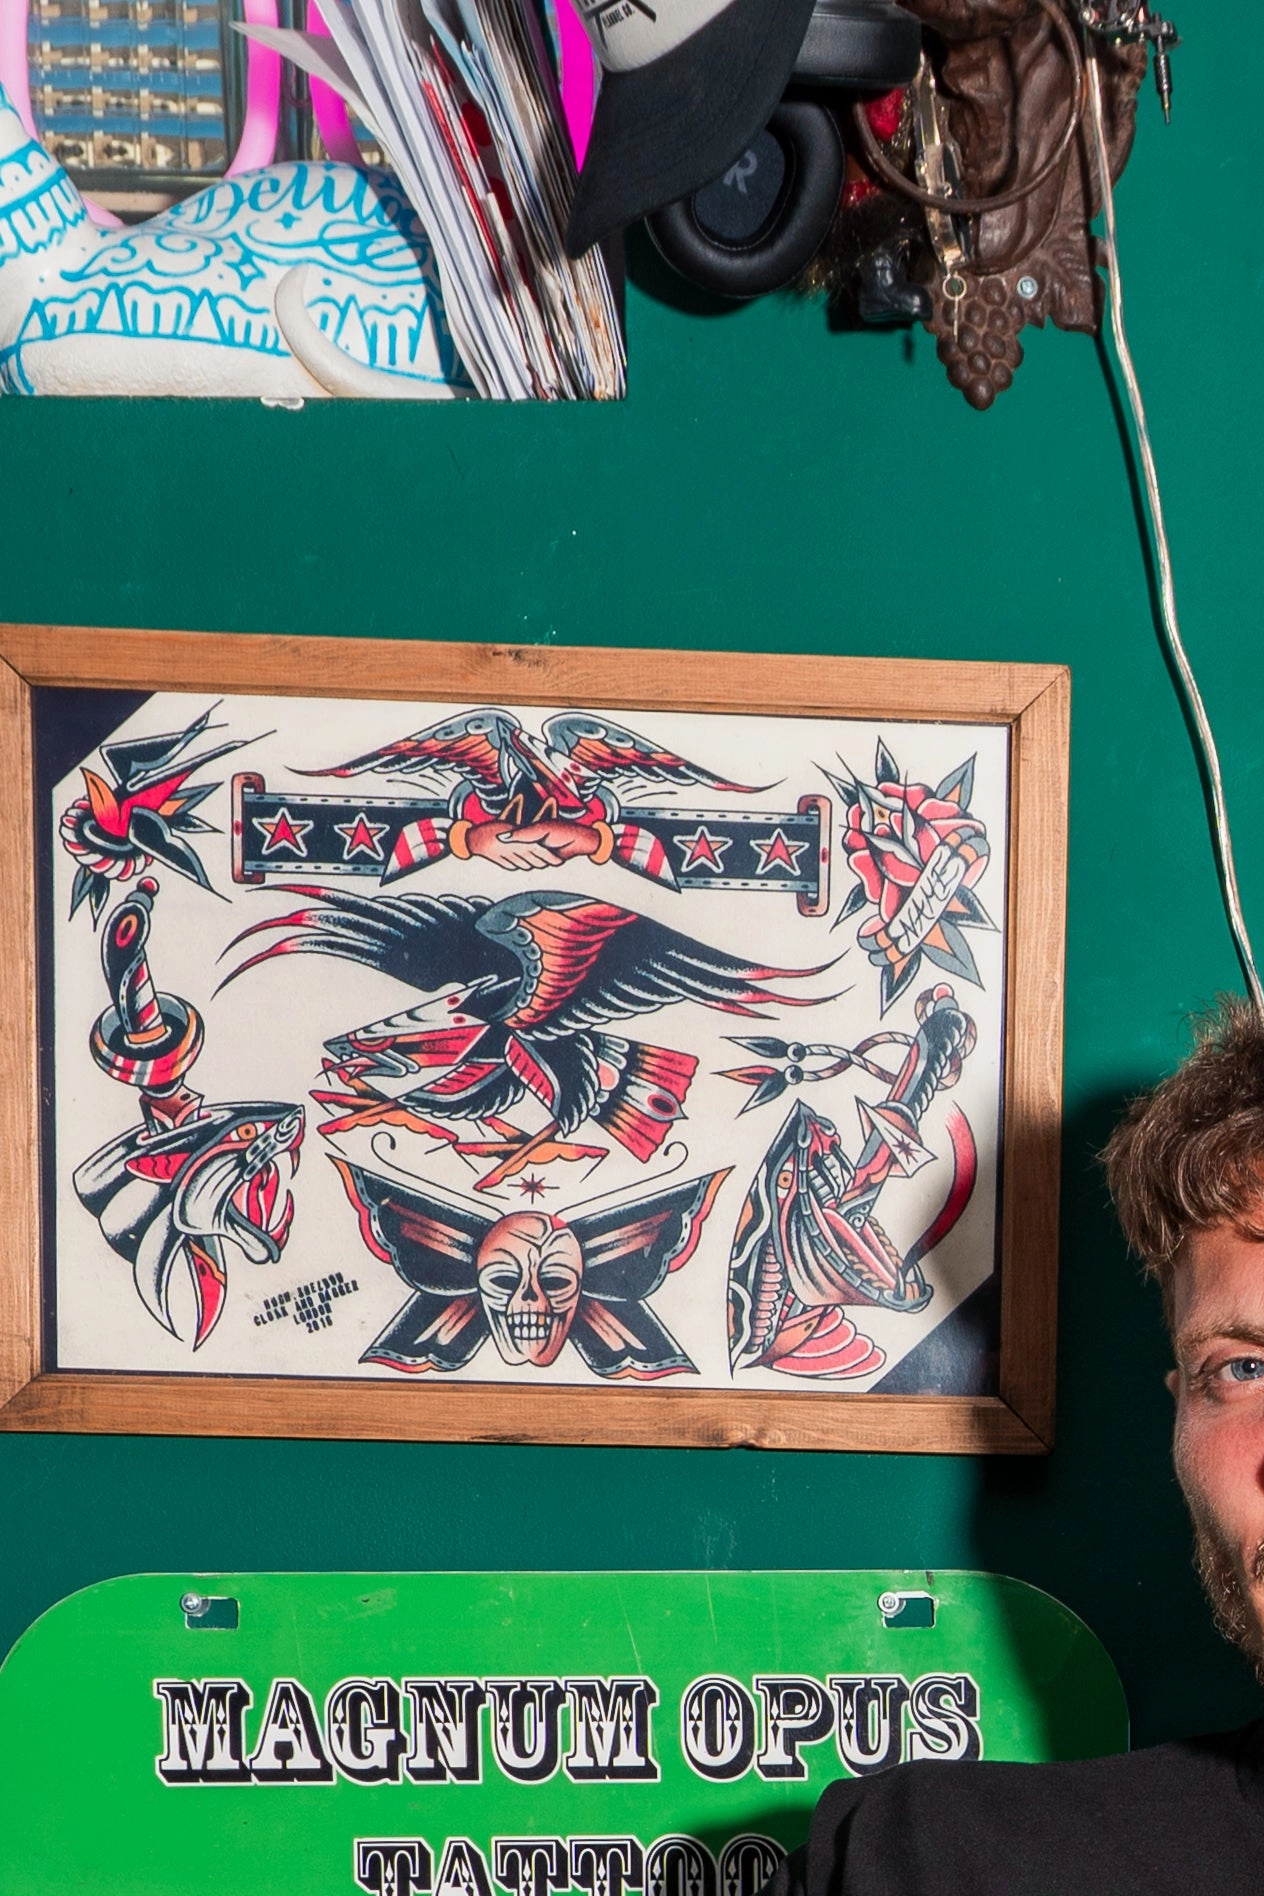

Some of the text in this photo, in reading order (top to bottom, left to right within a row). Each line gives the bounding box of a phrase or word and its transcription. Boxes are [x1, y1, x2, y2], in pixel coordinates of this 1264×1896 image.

[722, 151, 758, 194] R
[898, 849, 961, 948] NAME
[253, 1279, 360, 1327] CLOAK AND DAGGER
[263, 1271, 345, 1310] HUGH SHELDON
[293, 1302, 333, 1325] LONDON
[305, 1315, 334, 1334] 2016
[153, 1672, 983, 1786] MAGNUM OPUS
